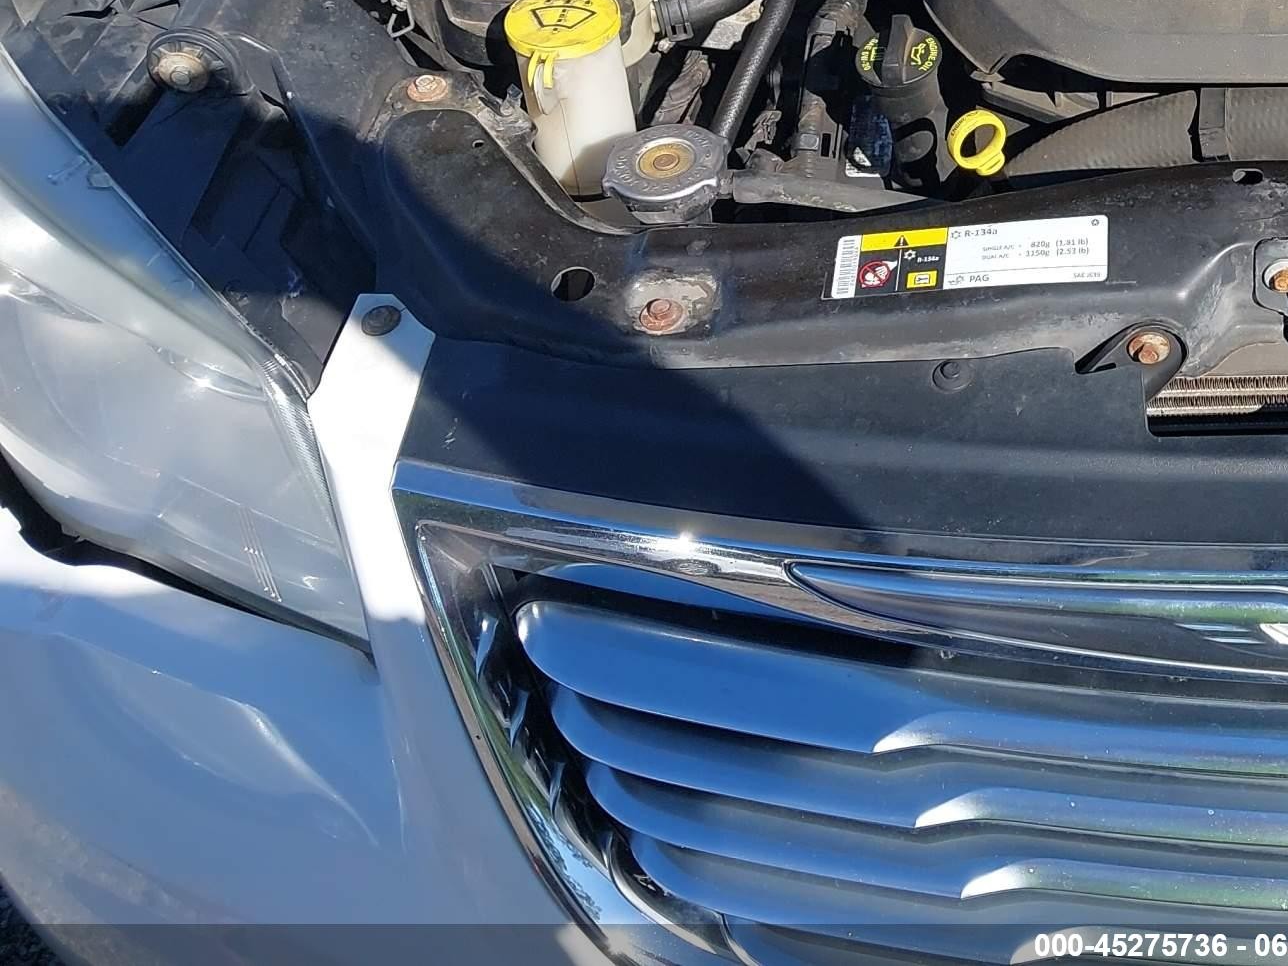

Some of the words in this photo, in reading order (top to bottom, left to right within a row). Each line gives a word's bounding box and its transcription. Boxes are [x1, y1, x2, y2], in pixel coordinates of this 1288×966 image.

[925, 37, 939, 63] ENGINE
[918, 59, 934, 72] OIL
[964, 227, 998, 239] R-134a
[1077, 237, 1089, 247] lb)
[1078, 246, 1090, 256] lb)
[969, 274, 990, 283] PAG
